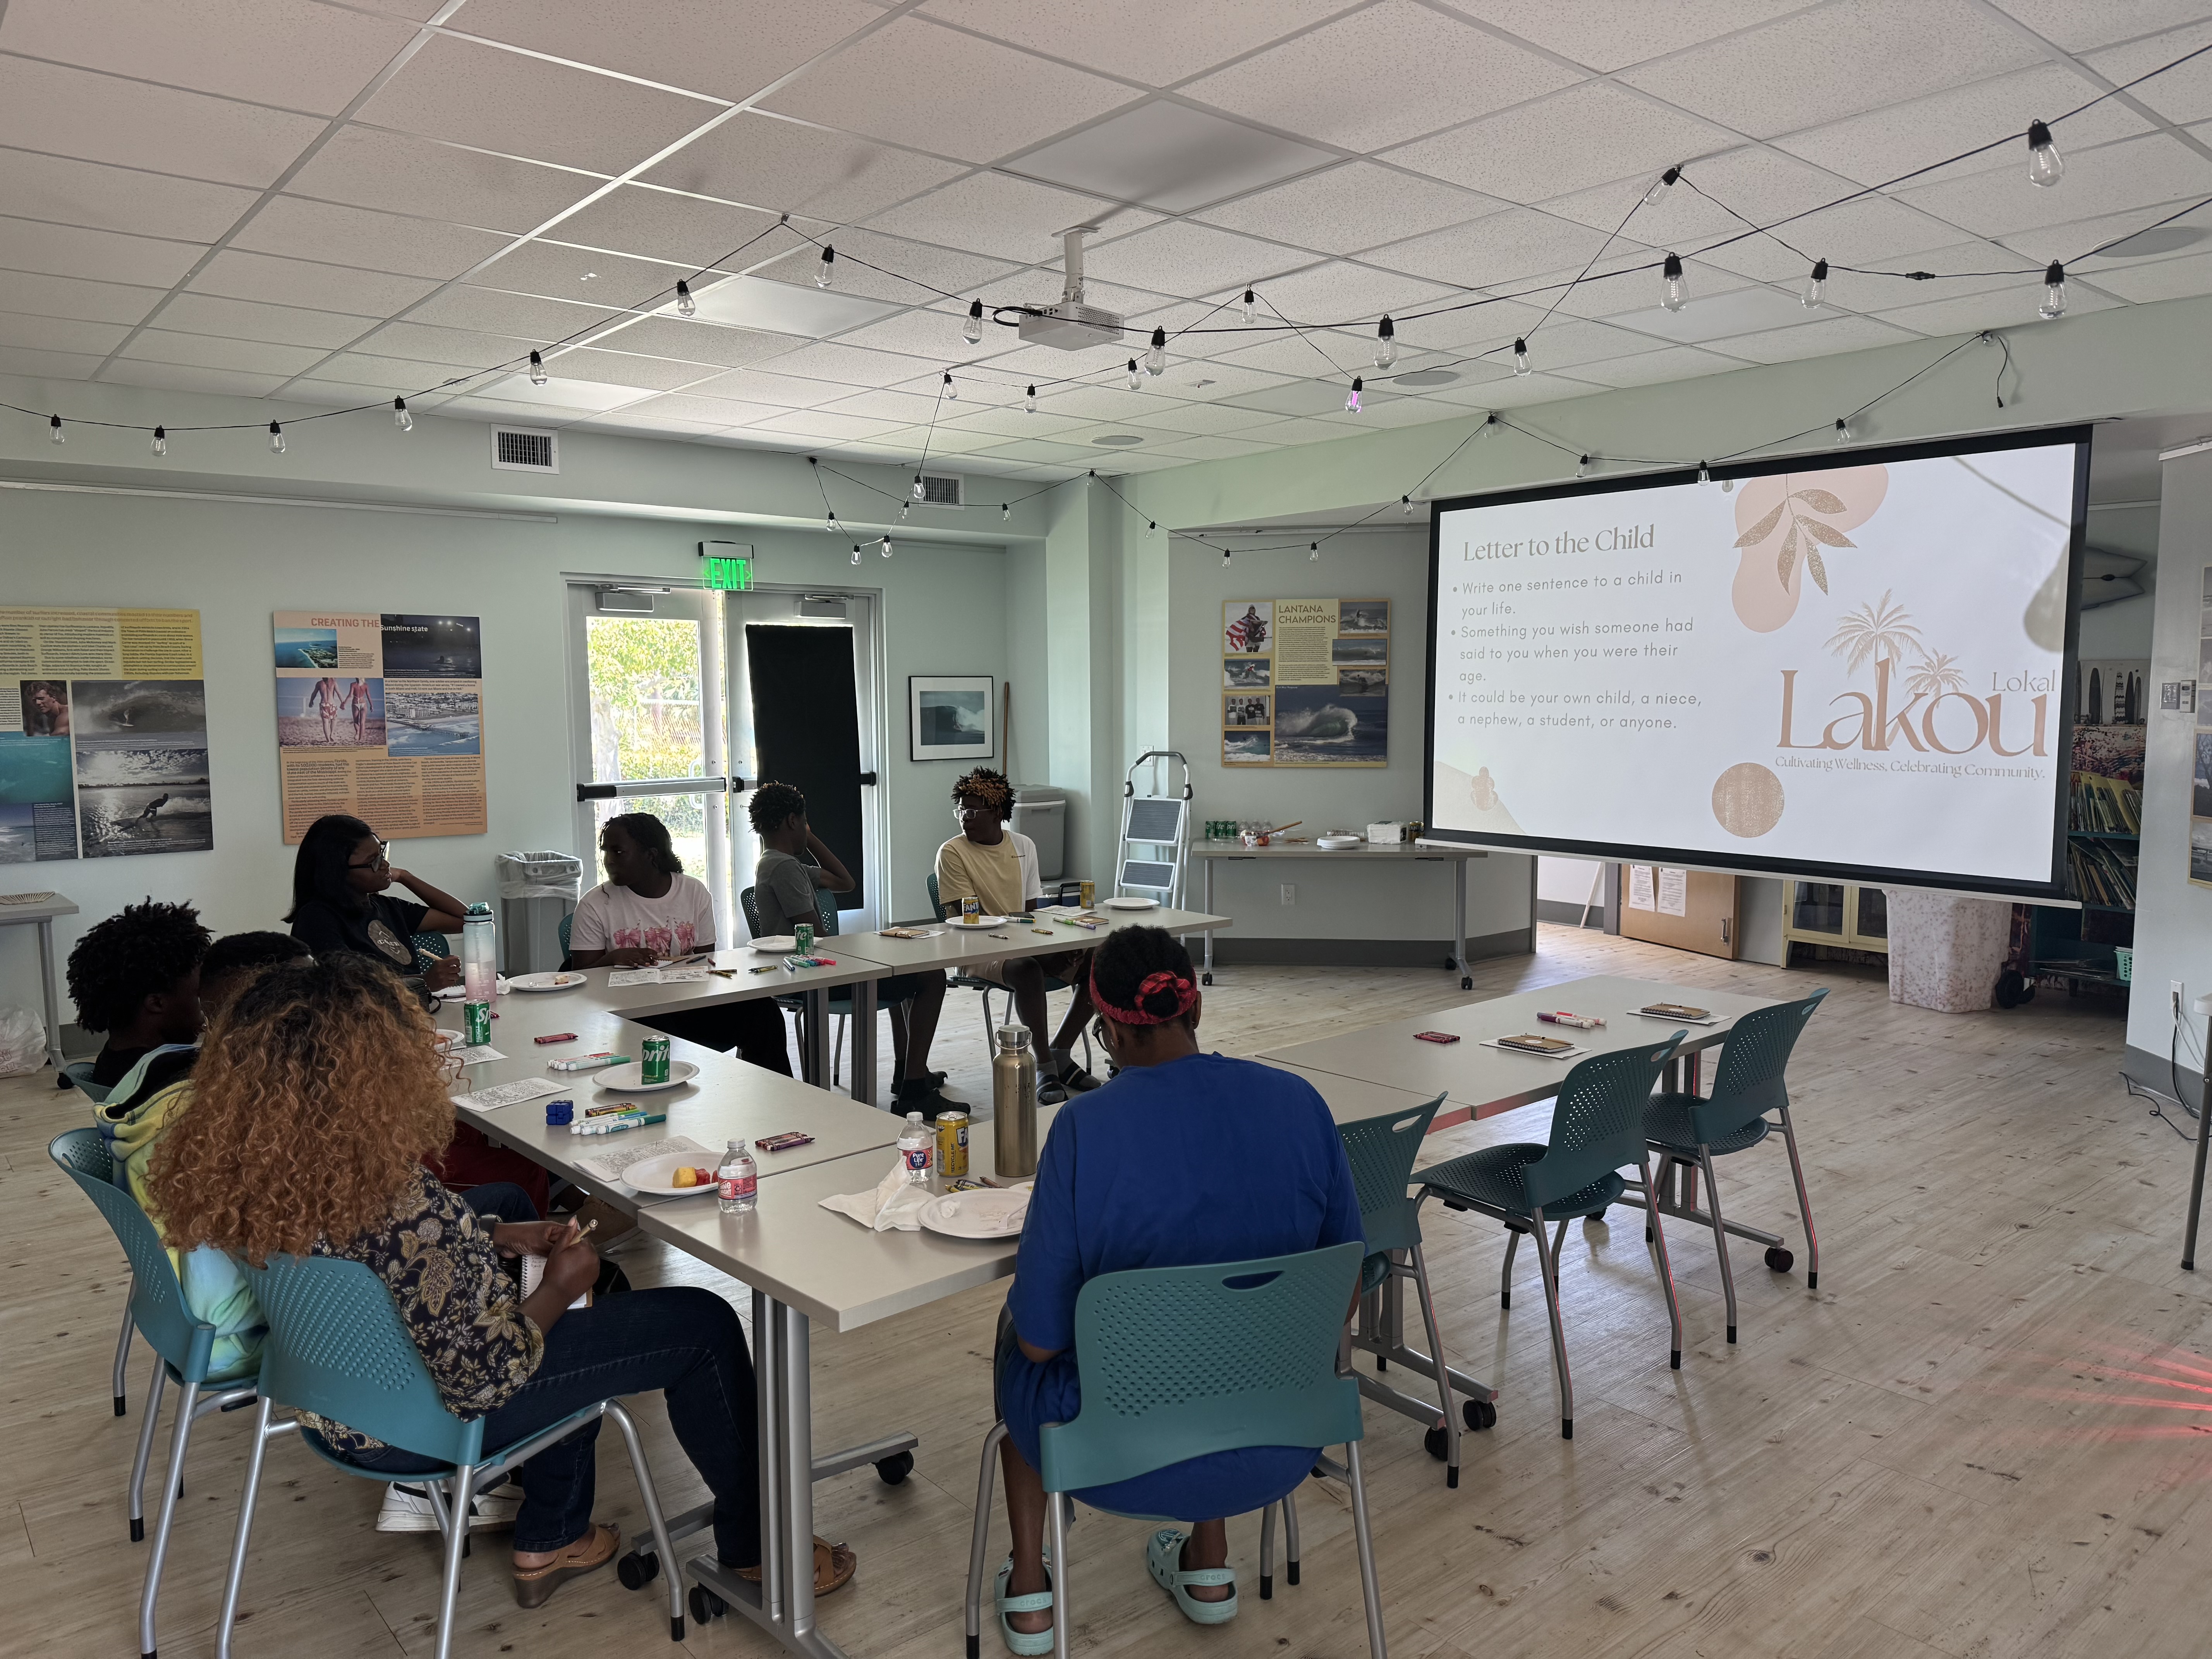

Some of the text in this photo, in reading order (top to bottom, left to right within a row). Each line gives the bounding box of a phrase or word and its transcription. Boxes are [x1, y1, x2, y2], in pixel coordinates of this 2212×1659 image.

[1464, 523, 1654, 561] Letter to the Child
[710, 558, 746, 589] EXIT
[1463, 569, 1682, 594] Write one sentence to a child in
[1279, 605, 1323, 613] LANTANA
[1279, 615, 1336, 623] CHAMPIONS
[1462, 601, 1515, 620] your life.
[311, 618, 380, 627] CREATING THE
[1462, 617, 1693, 640] Something you wish someone had
[1460, 642, 1678, 663] said to you when you were their
[1460, 673, 1486, 685] age.
[1992, 670, 2055, 692] Lokal
[1459, 690, 1701, 707] It could be your own child, a niece,
[1776, 658, 2049, 757] Lakou
[1470, 711, 1522, 728] nephew,
[1527, 717, 1534, 725] a
[1540, 713, 1594, 729] student,
[1600, 718, 1614, 727] or
[1620, 719, 1676, 732] anyone.
[1776, 756, 2045, 781] Cultivating Wellness, Celebrating Community.
[1020, 1597, 1047, 1606] crocs
